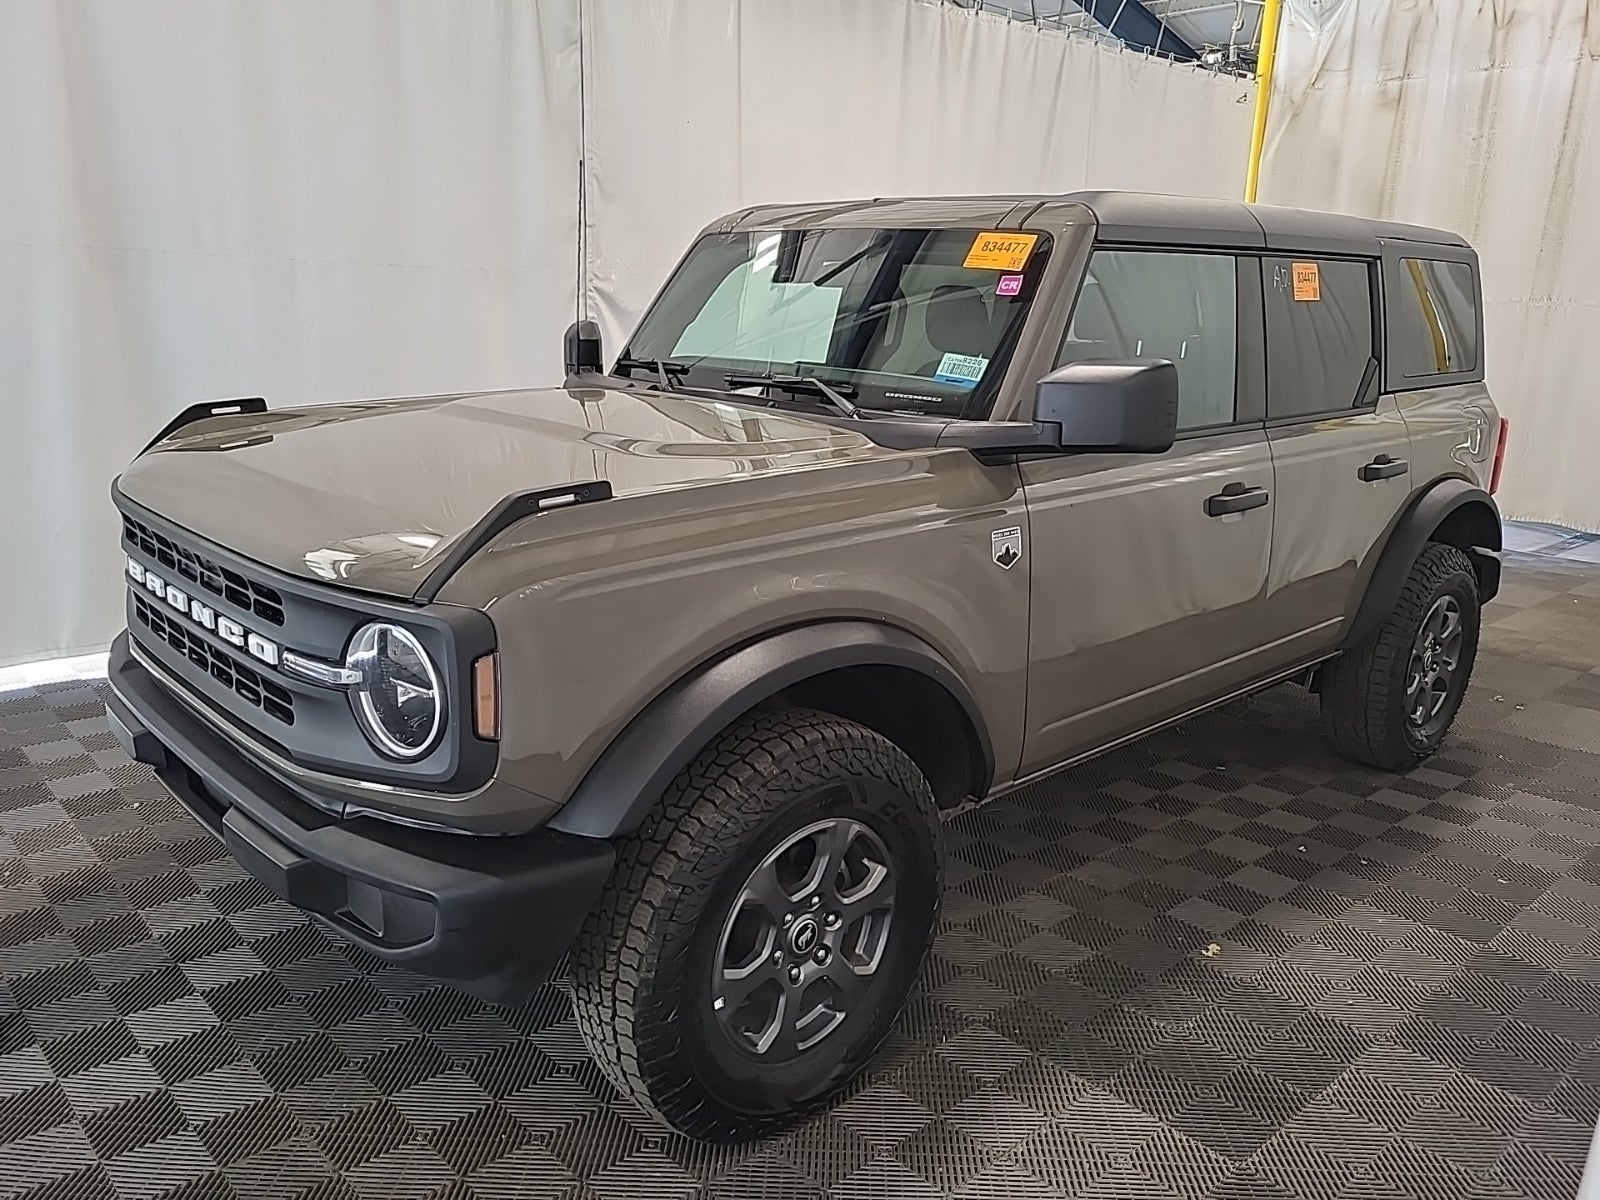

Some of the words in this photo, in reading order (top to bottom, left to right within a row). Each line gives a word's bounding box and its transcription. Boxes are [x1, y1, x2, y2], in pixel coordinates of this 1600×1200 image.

[981, 240, 1029, 254] 834477
[1297, 271, 1316, 284] 834477
[1001, 280, 1018, 290] CR
[885, 392, 943, 402] BRONCO
[127, 556, 279, 665] BRONCO
